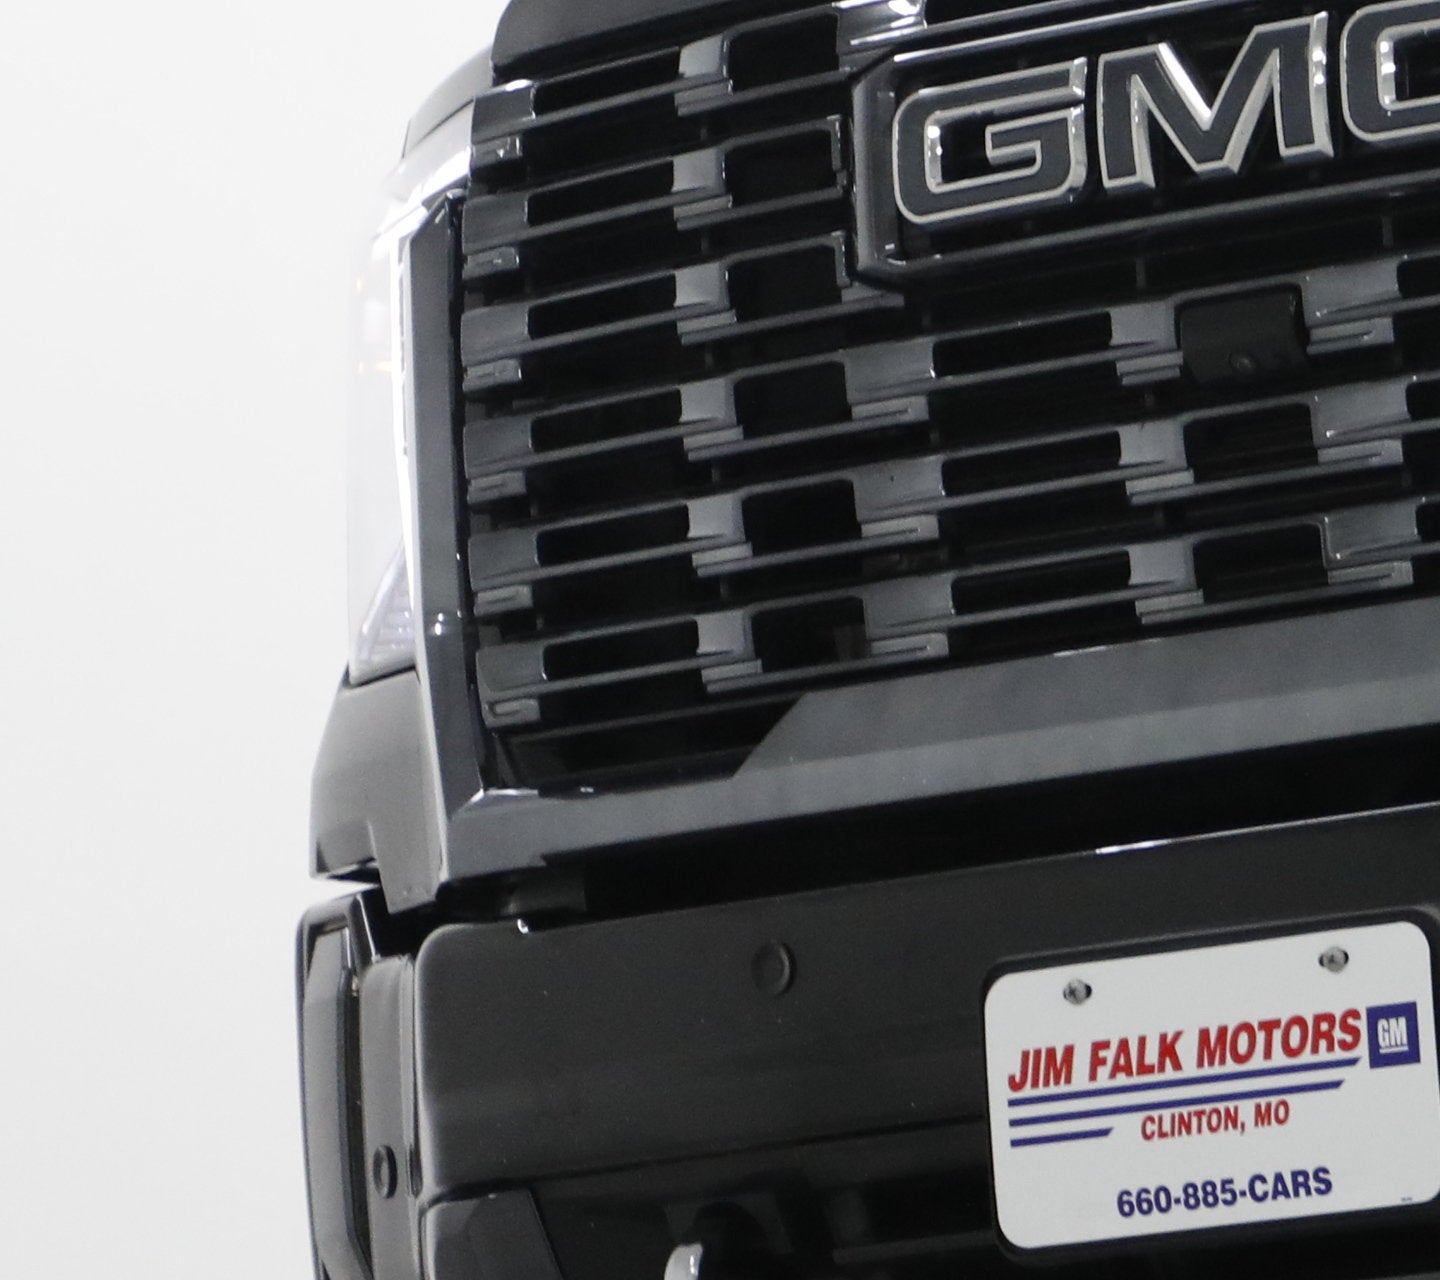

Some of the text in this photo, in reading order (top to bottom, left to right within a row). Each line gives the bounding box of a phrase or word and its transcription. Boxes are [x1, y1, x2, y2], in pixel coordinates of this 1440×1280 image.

[1008, 1008, 1362, 1092] JIM FALK MOTORS
[1377, 1016, 1409, 1052] GM
[1141, 1099, 1290, 1141] CLINTON, MO
[1117, 1167, 1333, 1218] 660-885-CARS
